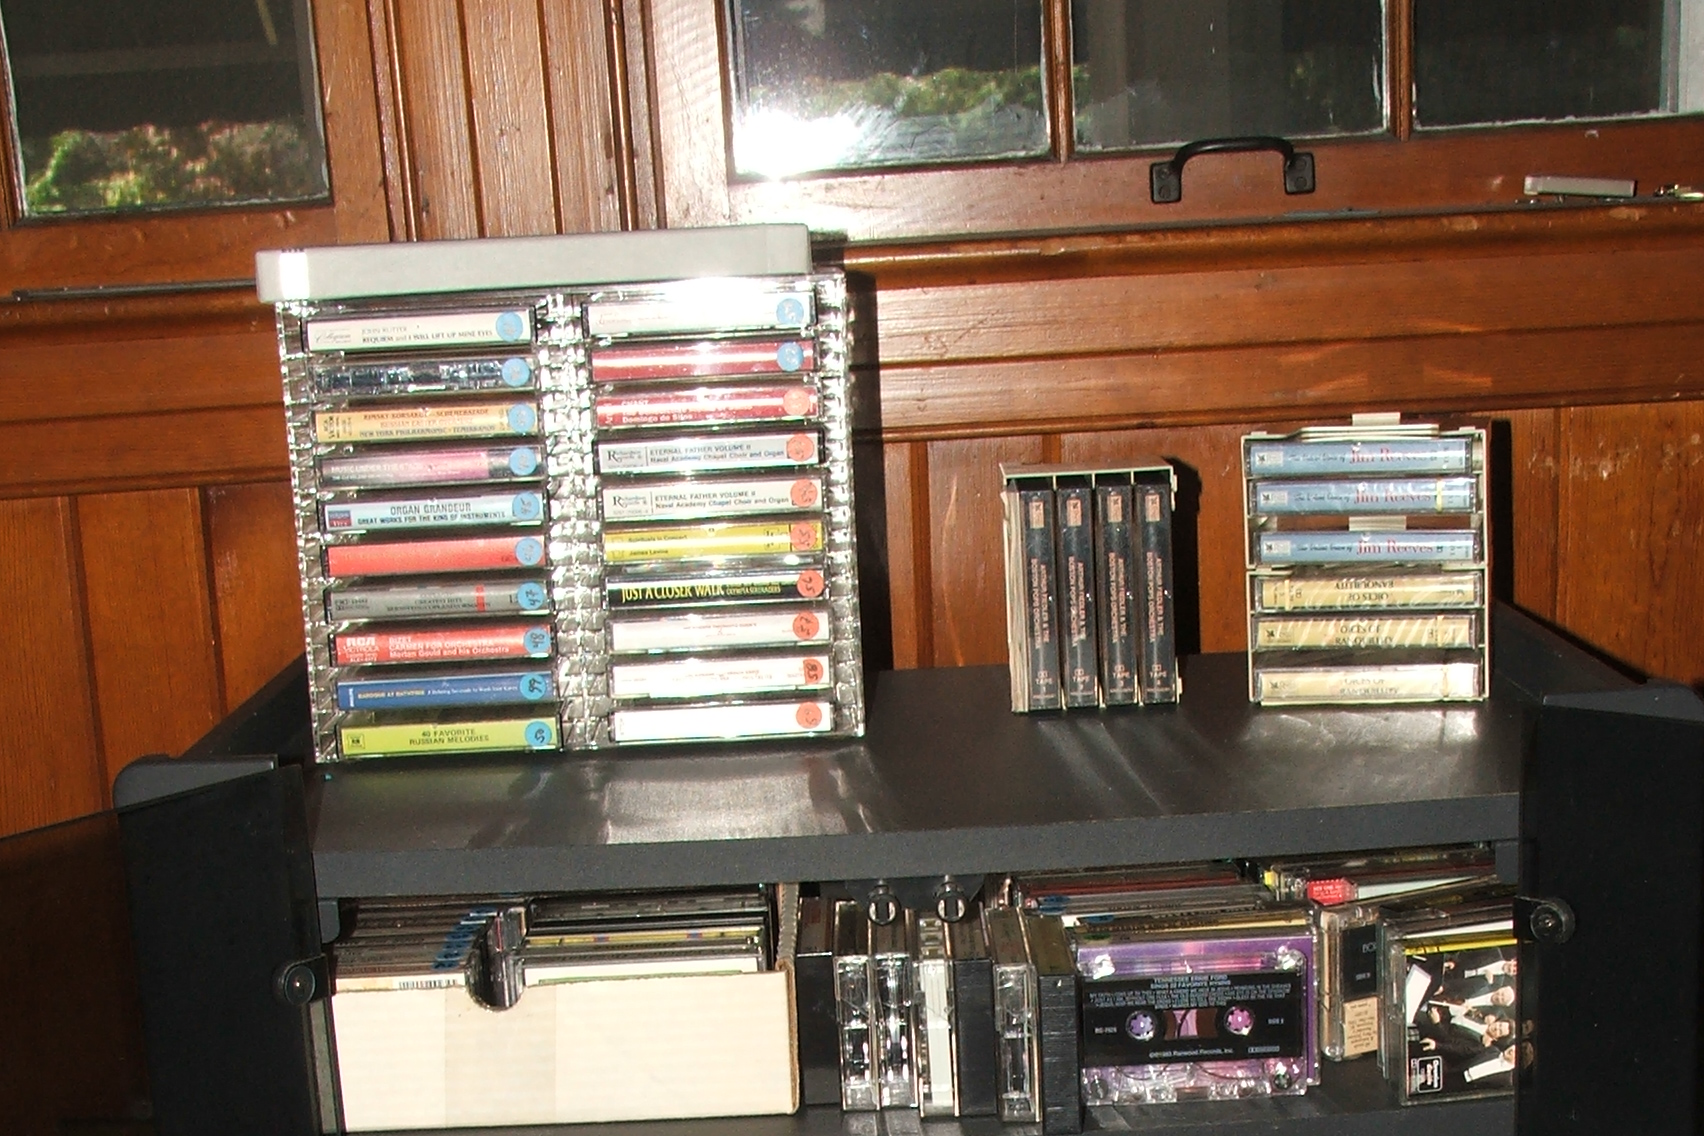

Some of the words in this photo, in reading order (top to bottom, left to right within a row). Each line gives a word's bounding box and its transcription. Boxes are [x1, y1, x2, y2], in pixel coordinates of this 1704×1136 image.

[447, 332, 457, 340] UP
[375, 429, 394, 437] YORK
[650, 446, 682, 456] ETERNAL
[684, 445, 712, 455] FATHER
[714, 444, 745, 453] VOLUME
[764, 449, 785, 459] Organ
[655, 492, 687, 501] ETERNAL
[690, 491, 718, 500] FATHER
[719, 490, 750, 499] VOLUME
[1353, 488, 1380, 504] Jim
[1384, 489, 1431, 503] Reeves
[390, 504, 421, 515] ORGAN
[423, 502, 471, 513] GRANDEUR
[655, 500, 675, 510] Naval
[676, 499, 706, 509] Academy
[768, 495, 789, 505] Organ
[1357, 538, 1382, 555] Jim
[1387, 538, 1434, 554] Reeves
[621, 587, 644, 604] JUST
[645, 587, 653, 599] A
[653, 585, 693, 599] CLOSER
[695, 584, 725, 597] WALK
[346, 637, 376, 646] RCA
[389, 642, 424, 650] CARMEN
[426, 641, 441, 649] FOR
[444, 639, 494, 648] ORCHESTRA
[530, 632, 545, 648] 48
[443, 648, 457, 656] and
[472, 645, 510, 655] Orchestra
[805, 663, 820, 681] 58
[422, 729, 432, 738] 40
[433, 728, 476, 737] FAVORITE
[409, 736, 446, 746] RUSSIAN
[447, 734, 490, 744] MELODIES
